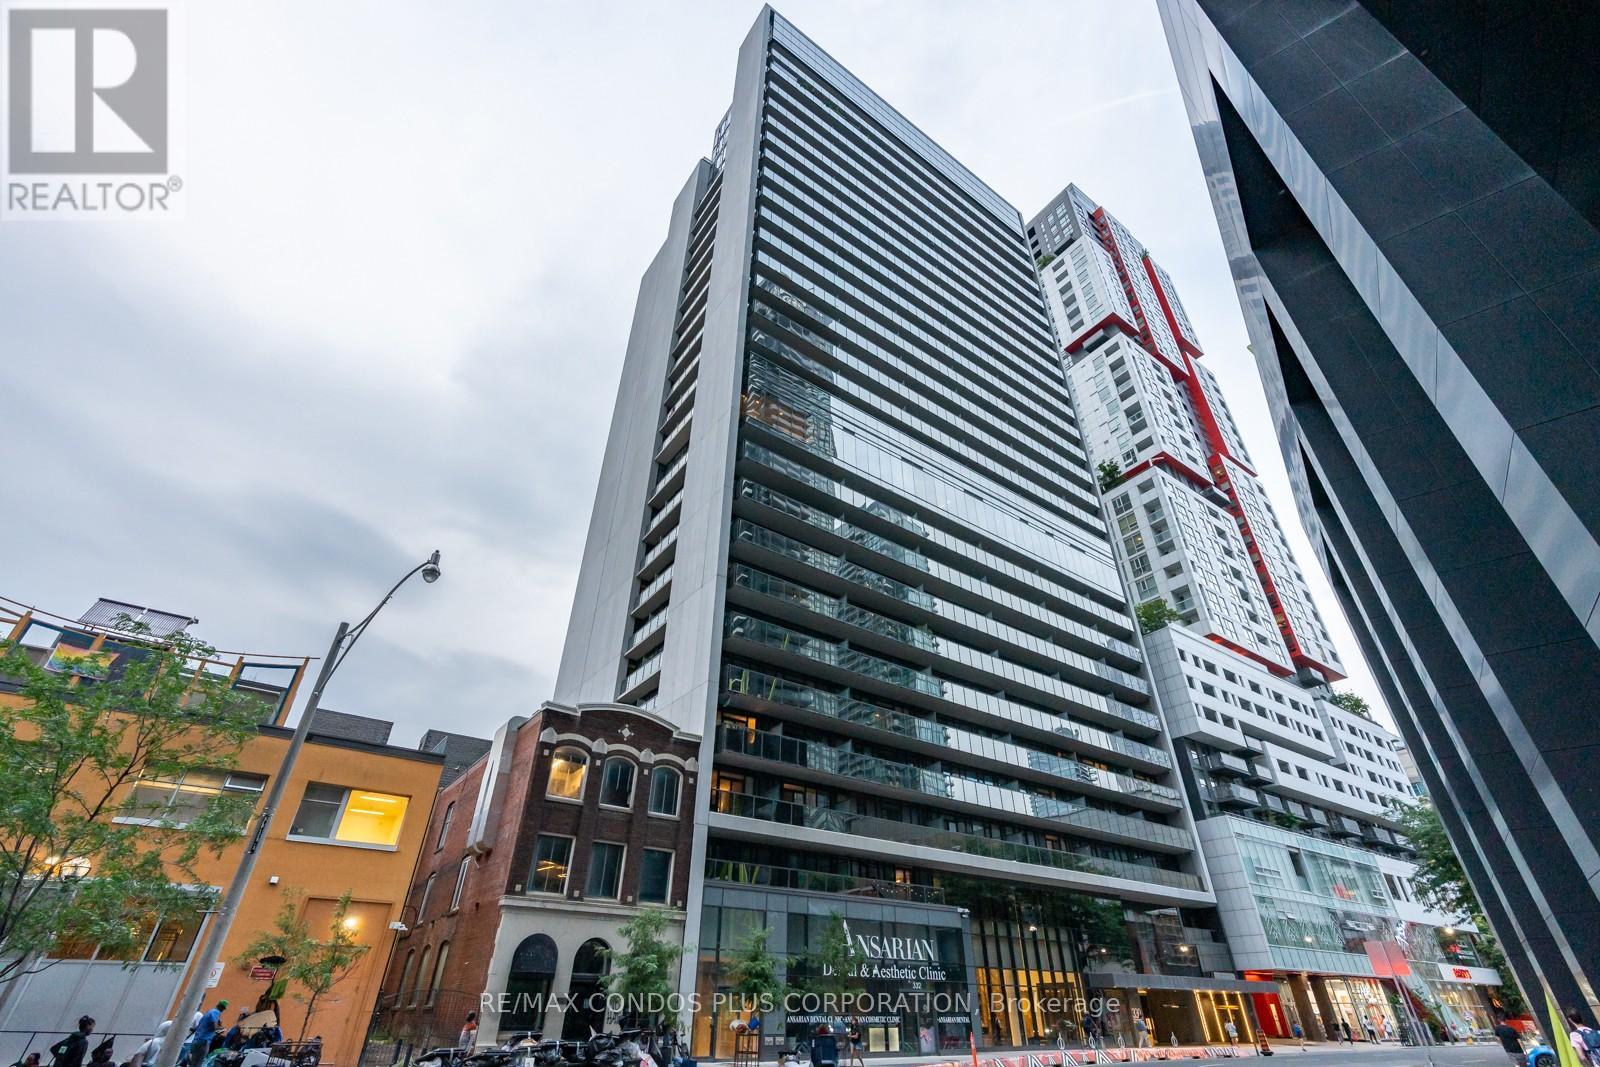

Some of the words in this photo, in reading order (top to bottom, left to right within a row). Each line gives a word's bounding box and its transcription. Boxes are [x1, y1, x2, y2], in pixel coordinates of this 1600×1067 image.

[841, 919, 934, 961] ANSARIAN
[823, 963, 857, 977] Dal
[861, 963, 870, 978] &
[872, 964, 917, 980] Aesthetic
[919, 966, 946, 981] Clinic
